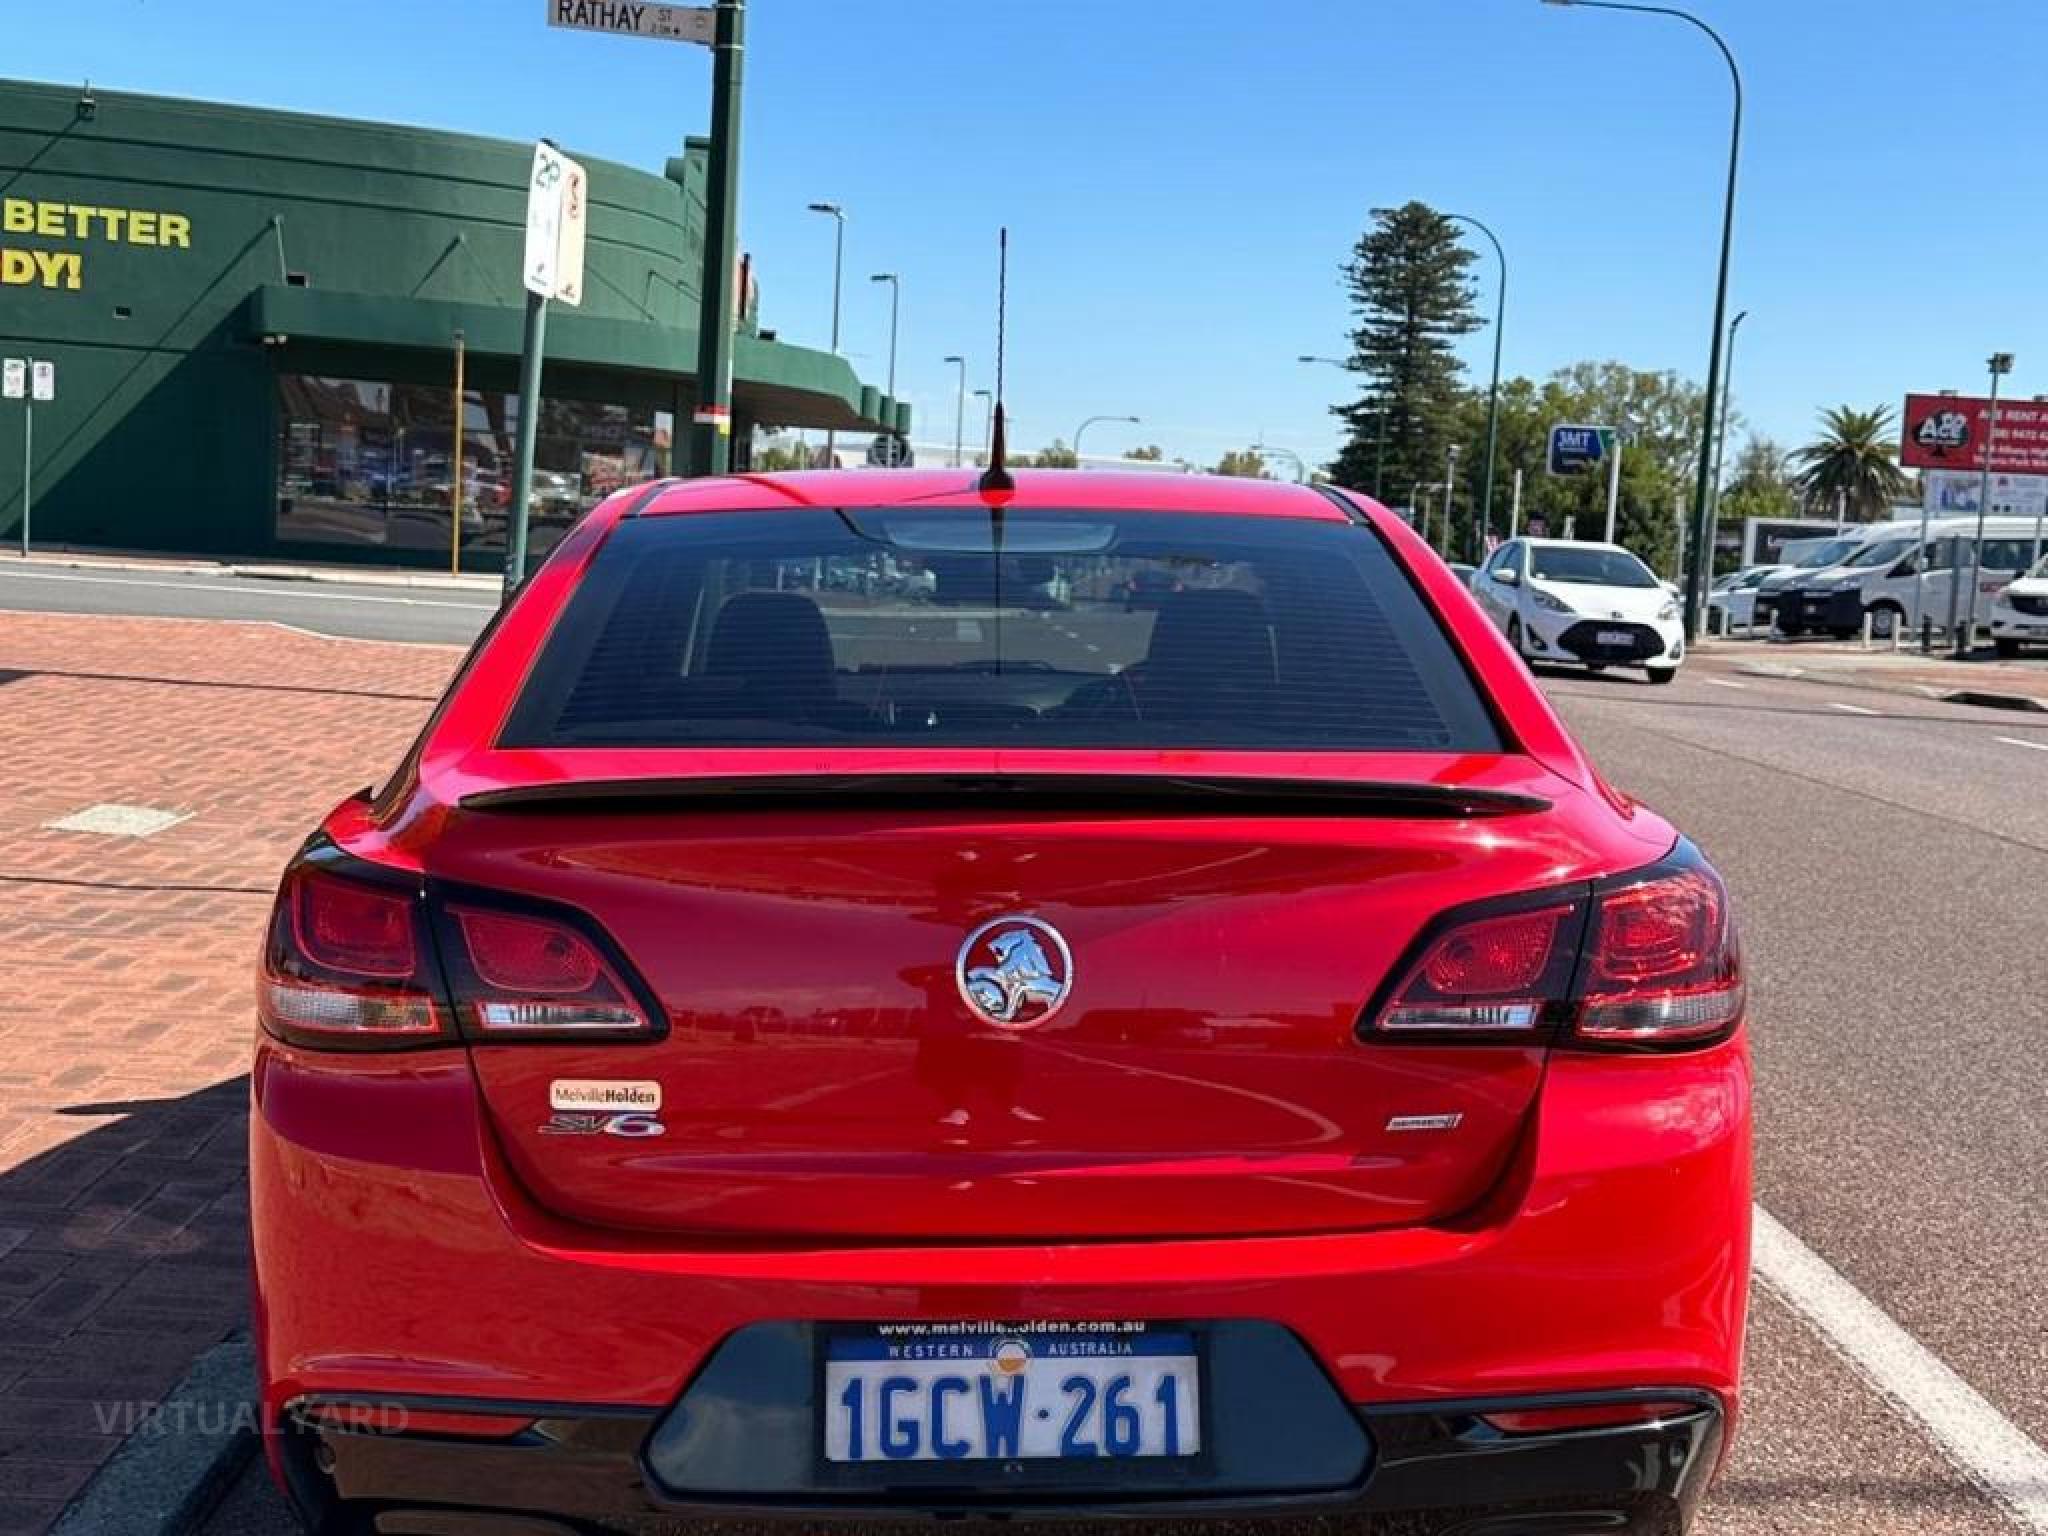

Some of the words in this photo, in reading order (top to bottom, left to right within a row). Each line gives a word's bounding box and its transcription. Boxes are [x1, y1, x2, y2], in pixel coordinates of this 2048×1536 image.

[557, 0, 644, 31] RATHAY
[3, 197, 192, 249] BETTER
[1, 248, 81, 290] DY!
[555, 1087, 655, 1105] MelvilleHolden
[889, 1344, 974, 1359] WESTERN
[1048, 1342, 1134, 1357] AUSTRALIA
